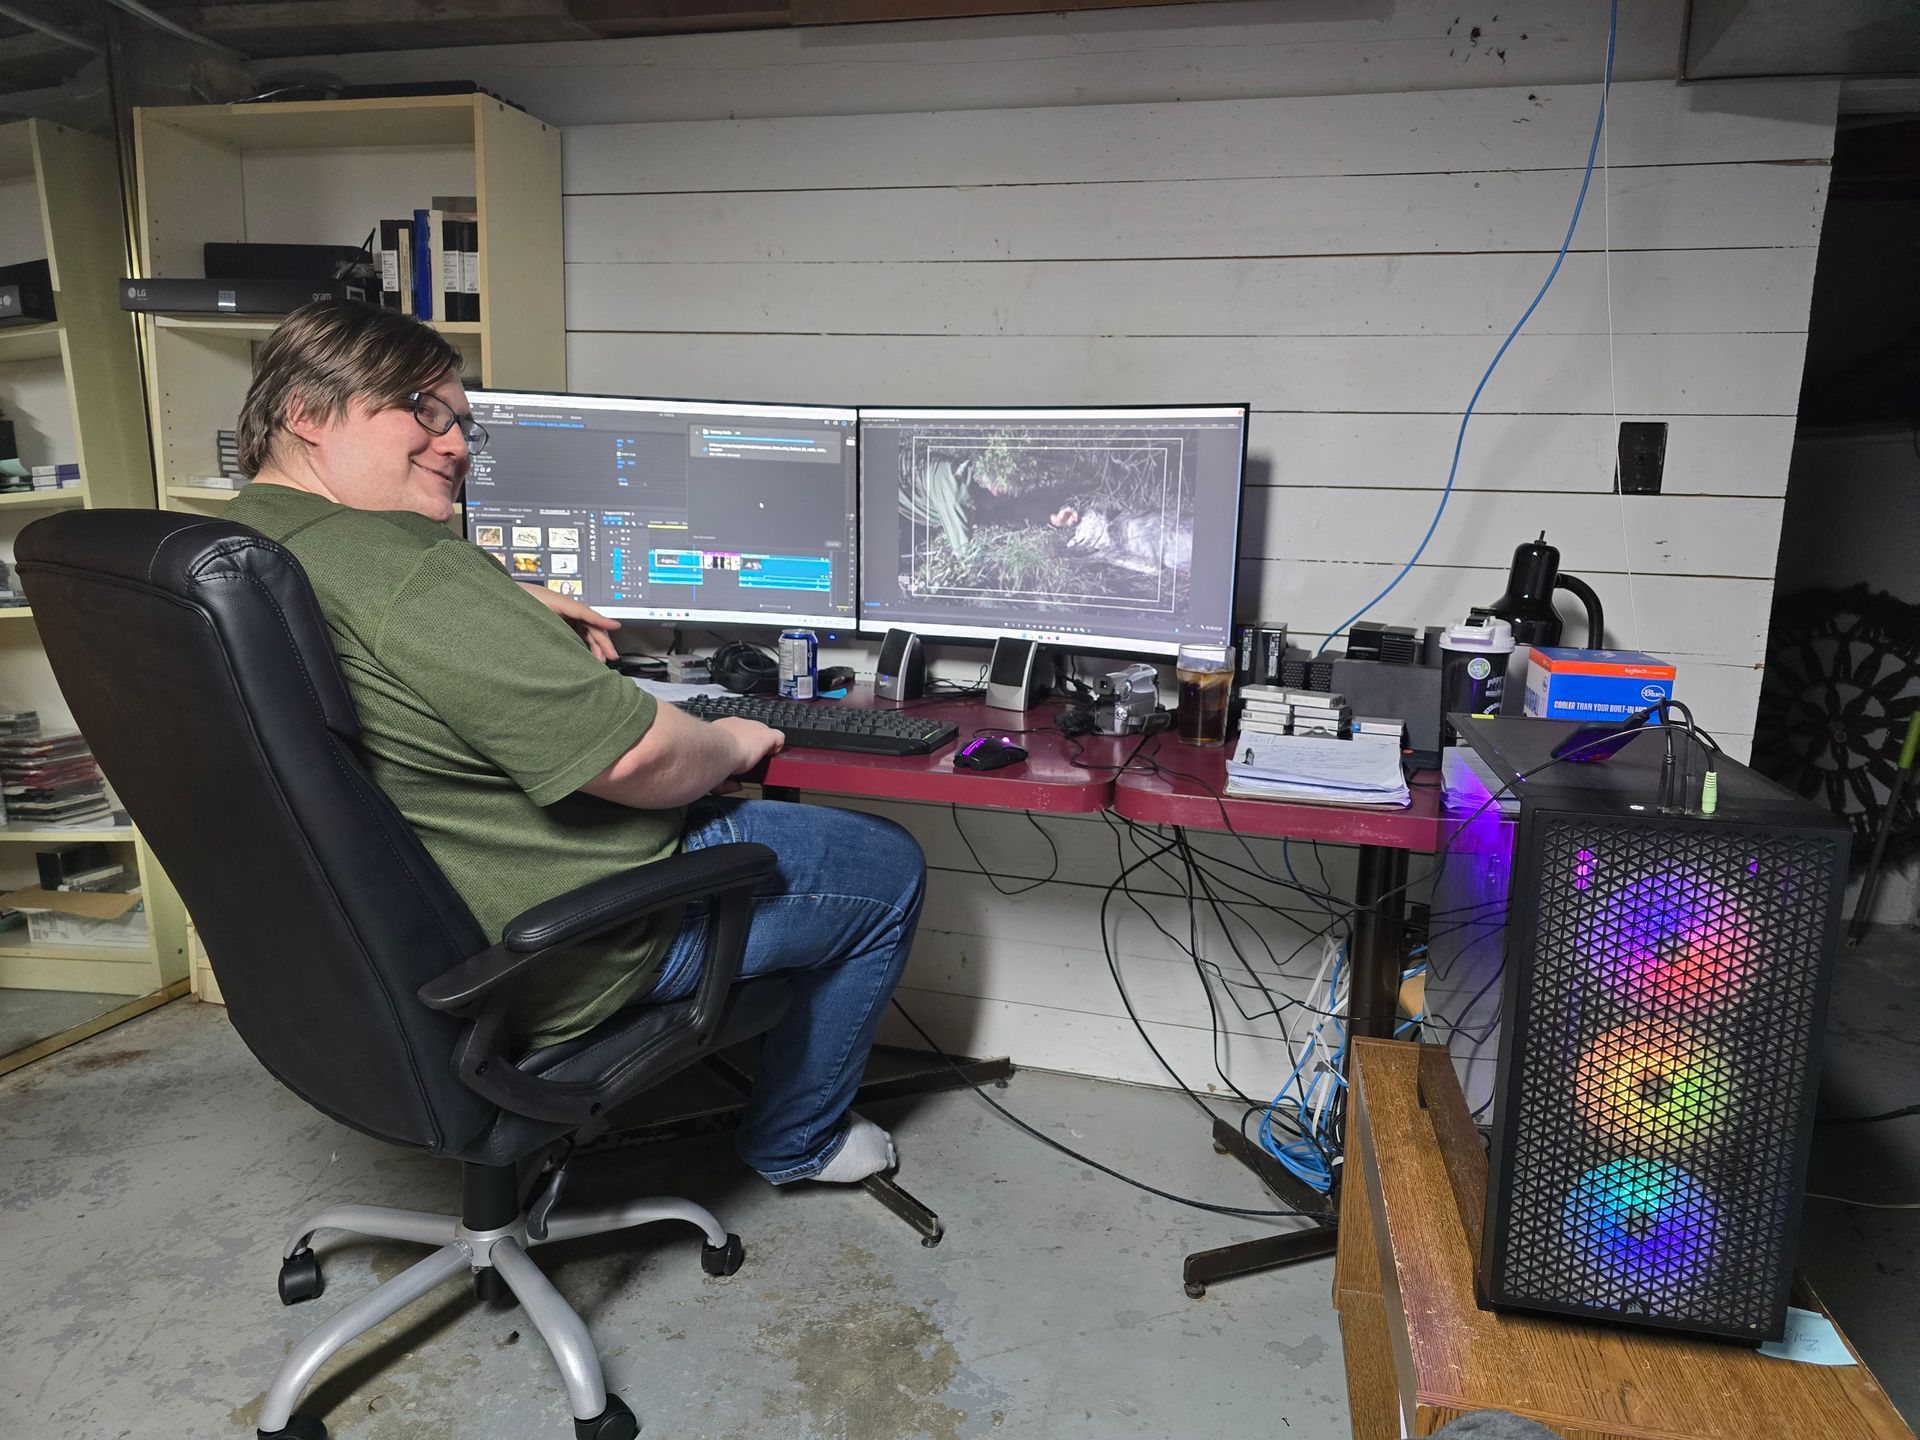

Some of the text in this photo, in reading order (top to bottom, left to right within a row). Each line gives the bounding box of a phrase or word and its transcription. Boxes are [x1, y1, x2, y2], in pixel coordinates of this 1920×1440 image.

[137, 289, 147, 297] LG
[312, 292, 332, 302] gram
[1624, 667, 1648, 676] logitech
[1554, 700, 1576, 710] COOLER
[1577, 702, 1593, 711] THAN
[1593, 703, 1609, 712] YOUR
[1610, 704, 1634, 714] BUILT-IN
